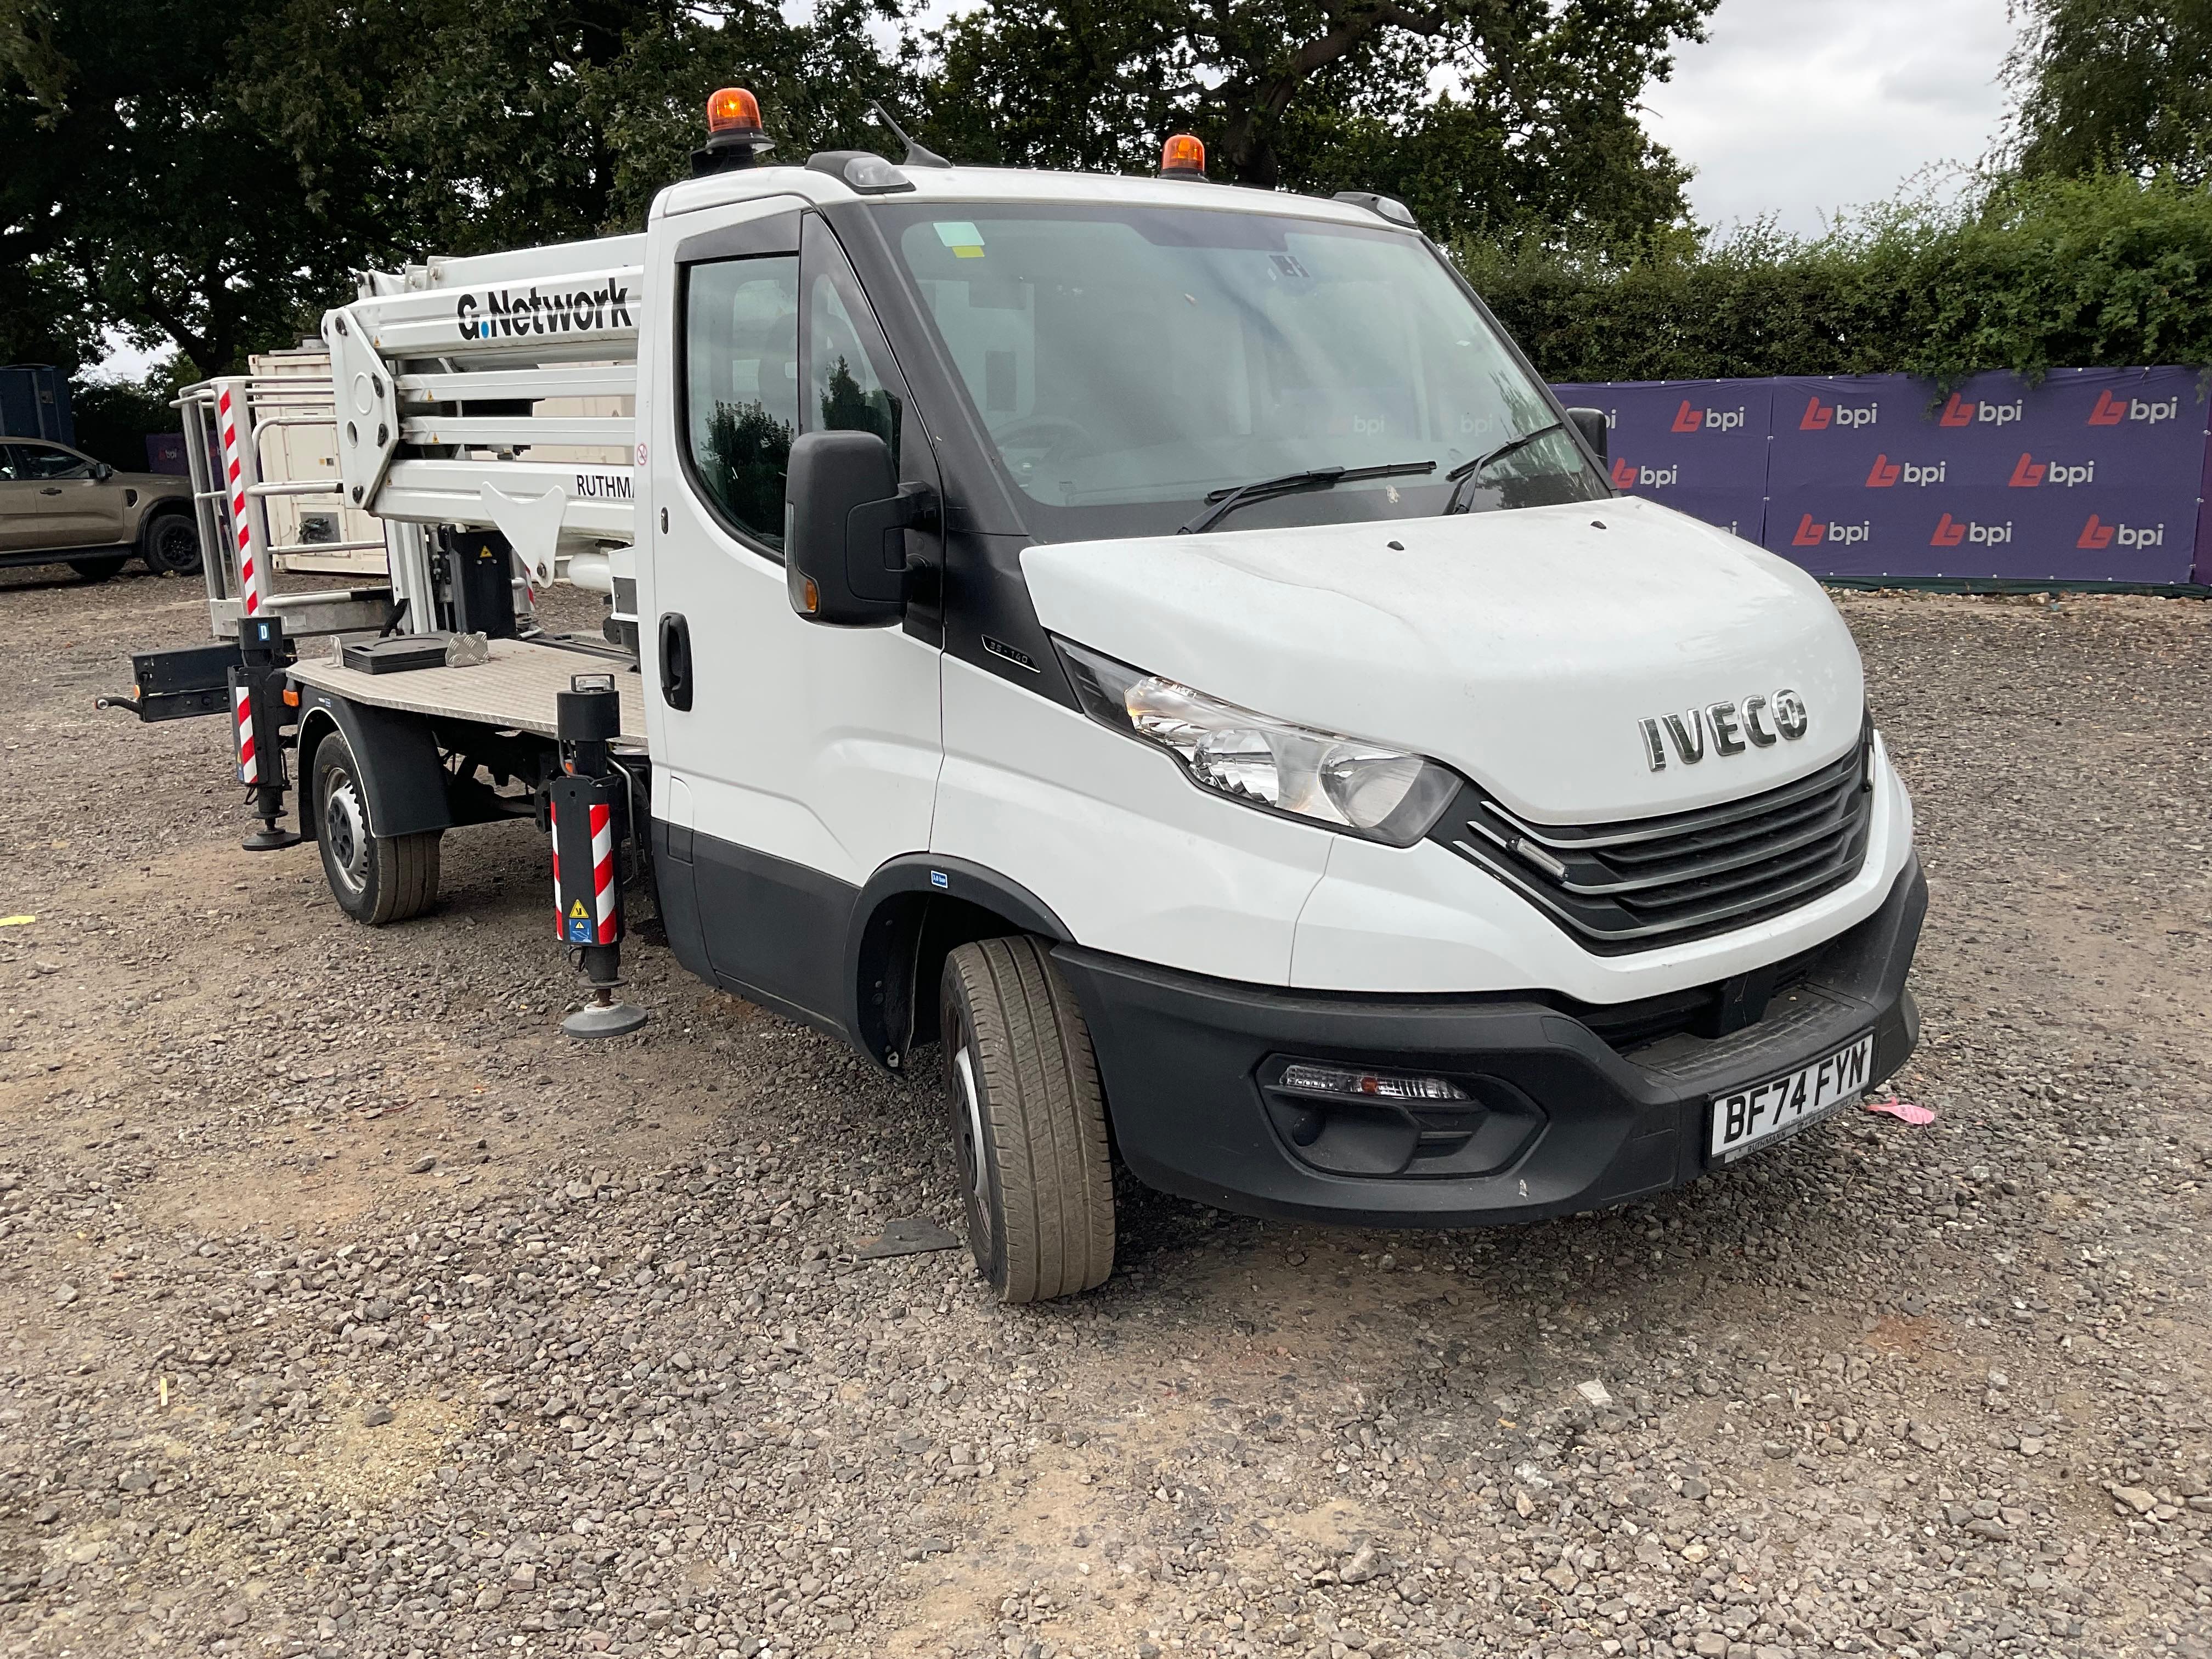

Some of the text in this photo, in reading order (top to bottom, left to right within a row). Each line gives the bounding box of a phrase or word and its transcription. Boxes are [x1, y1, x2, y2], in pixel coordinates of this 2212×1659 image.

[1706, 406, 1746, 432] bpi
[1836, 402, 1878, 428] bpi
[1978, 399, 2023, 426] bpi
[2130, 396, 2178, 424] bpi
[1353, 413, 1385, 437] bpi
[1460, 413, 1493, 437] bpi
[576, 474, 635, 498] RUTHM
[1639, 464, 1678, 488] bpi
[1903, 460, 1946, 487] bpi
[2049, 460, 2095, 487] bpi
[1828, 520, 1870, 545] bpi
[1969, 521, 2012, 546] bpi
[2118, 523, 2164, 549] bpi
[260, 625, 268, 640] D
[1638, 689, 1808, 772] IVECO
[1723, 1070, 1807, 1144] BF74
[1814, 1040, 1866, 1107] FYN
